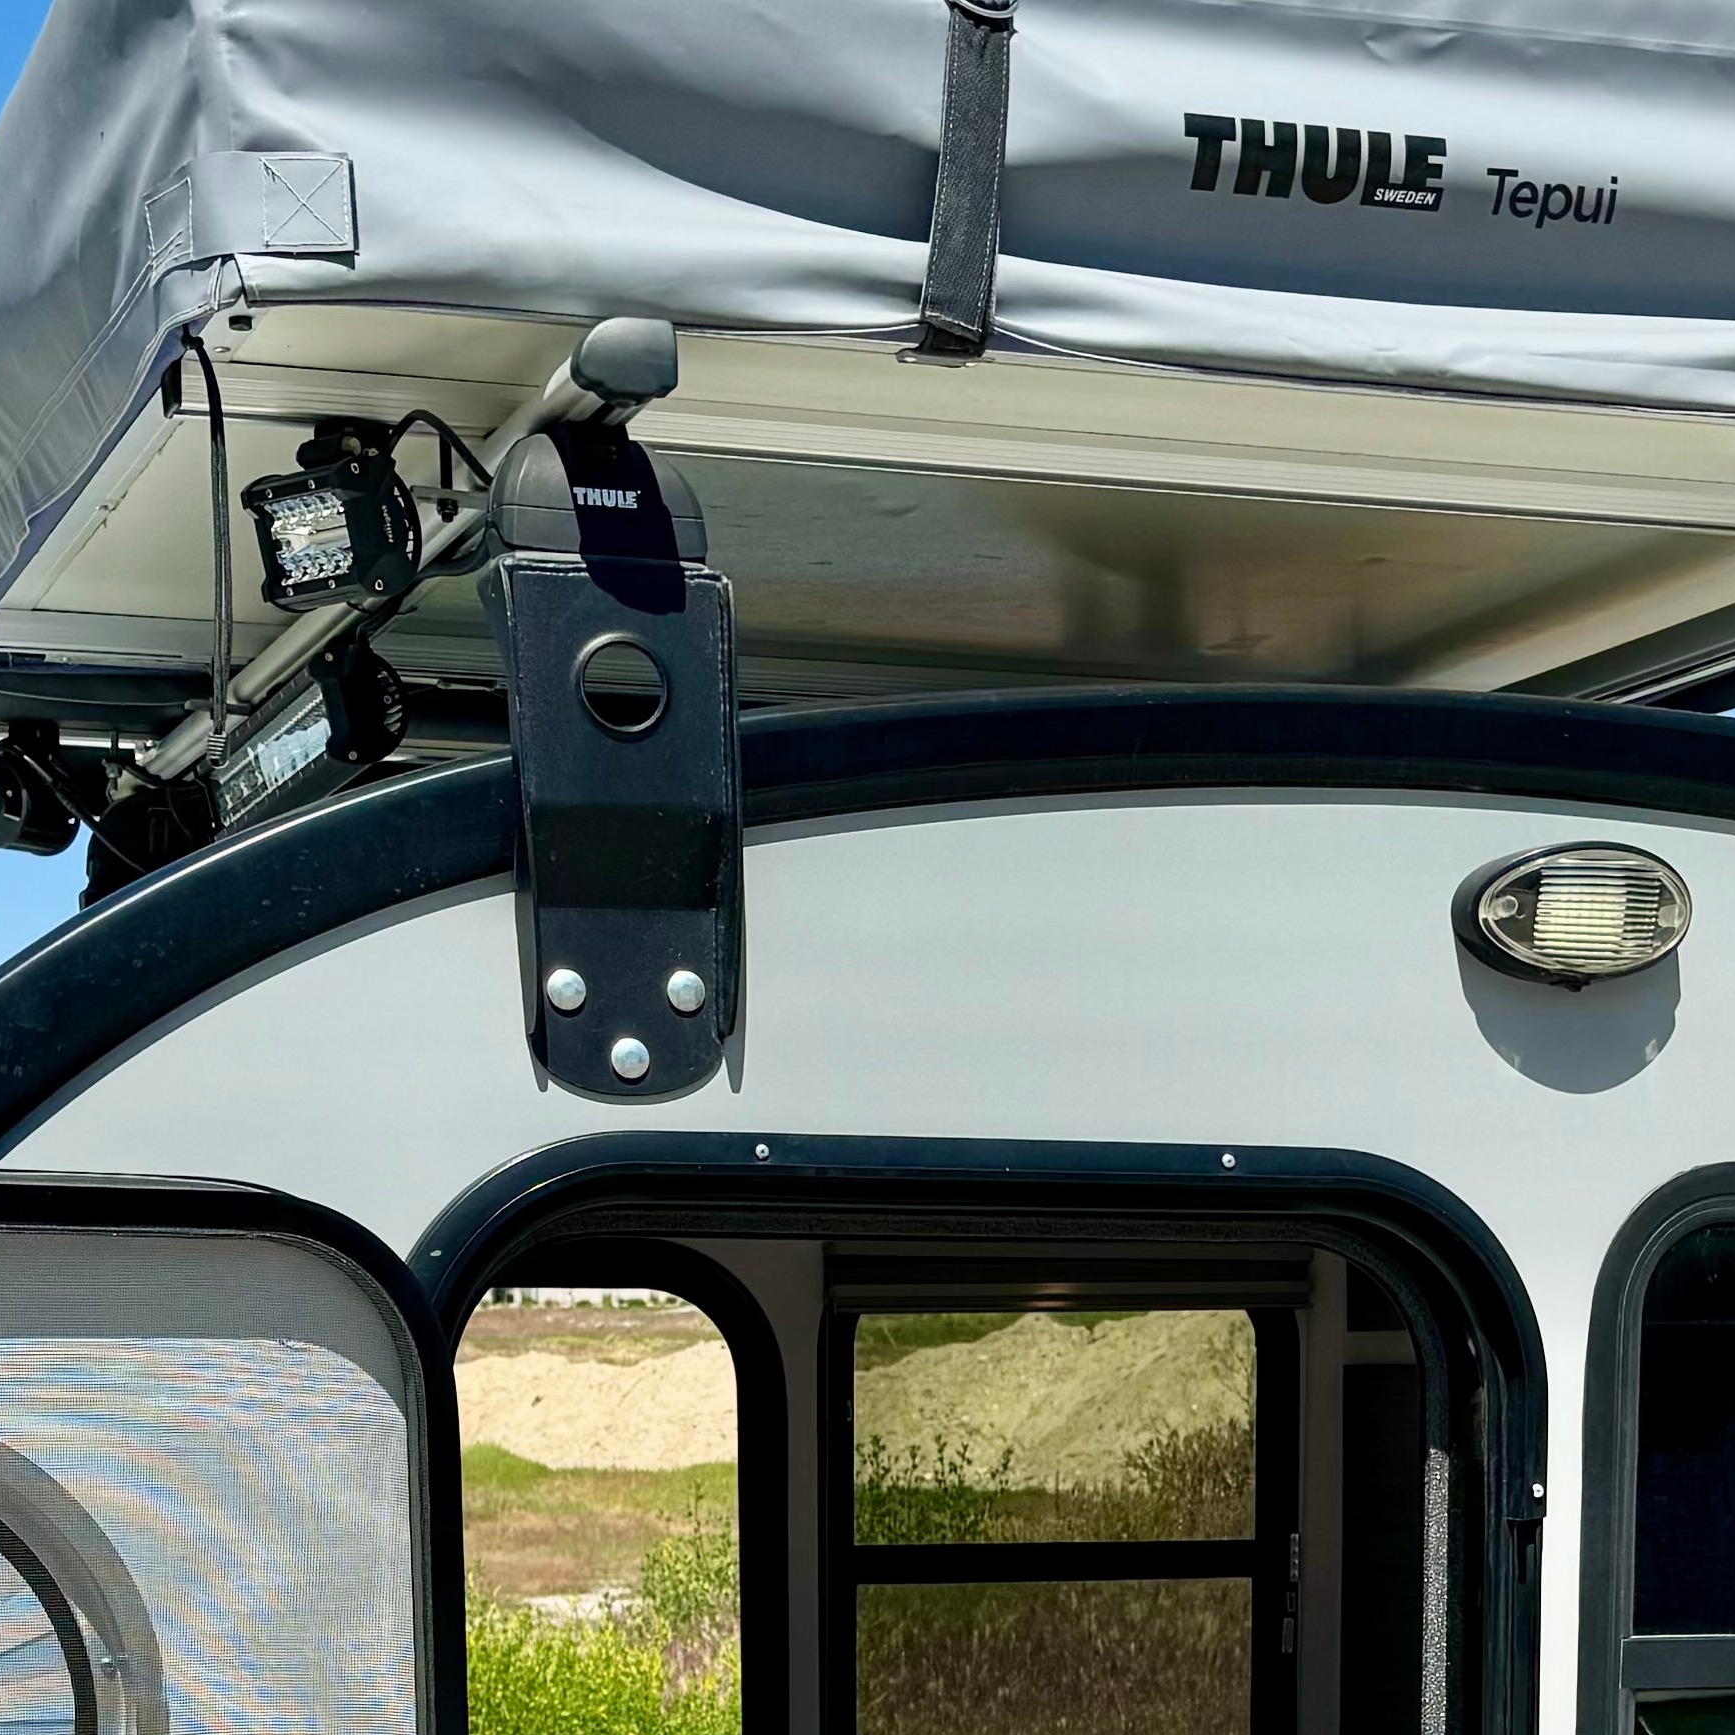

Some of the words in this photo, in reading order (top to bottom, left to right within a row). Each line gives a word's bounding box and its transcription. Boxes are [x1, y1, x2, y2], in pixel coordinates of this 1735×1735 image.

[1184, 113, 1447, 211] THULE
[1487, 167, 1618, 229] Tepui
[1373, 187, 1437, 206] SWEDEN
[573, 486, 638, 509] THULE
